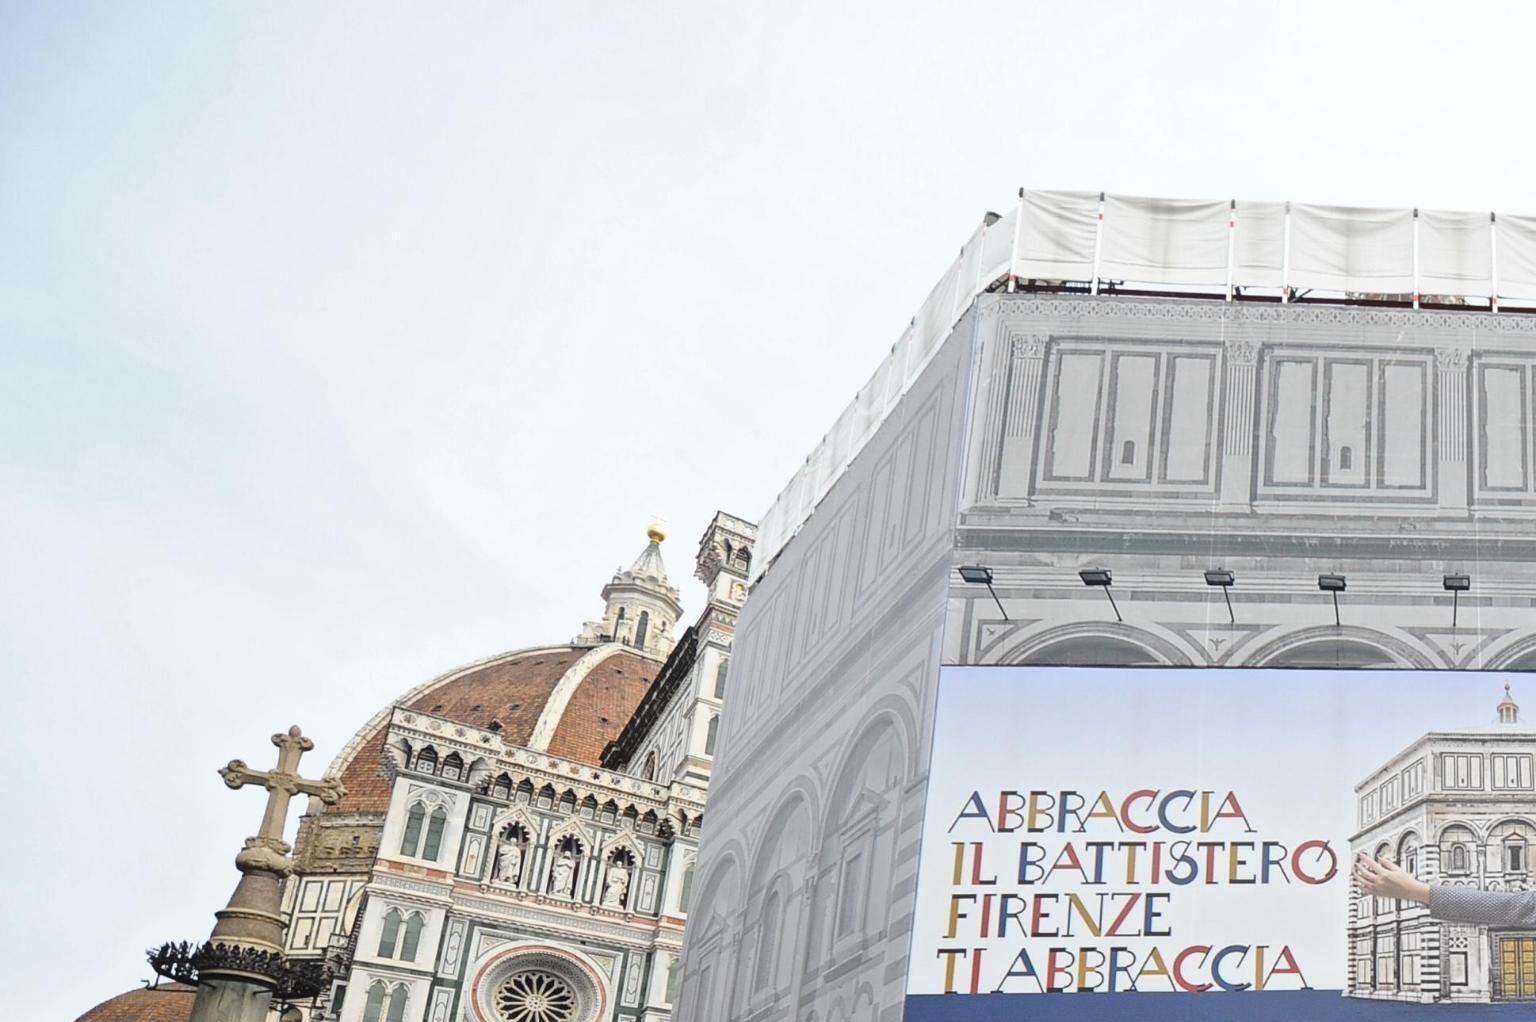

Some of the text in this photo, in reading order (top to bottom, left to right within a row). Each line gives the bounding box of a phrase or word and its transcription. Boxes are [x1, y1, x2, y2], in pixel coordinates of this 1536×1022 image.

[948, 789, 1257, 834] ABBRACCIA
[951, 839, 1338, 886] IL BATTISTERO
[942, 892, 1172, 938] FIRENZE
[937, 943, 1314, 994] TI ABBRACCIA
